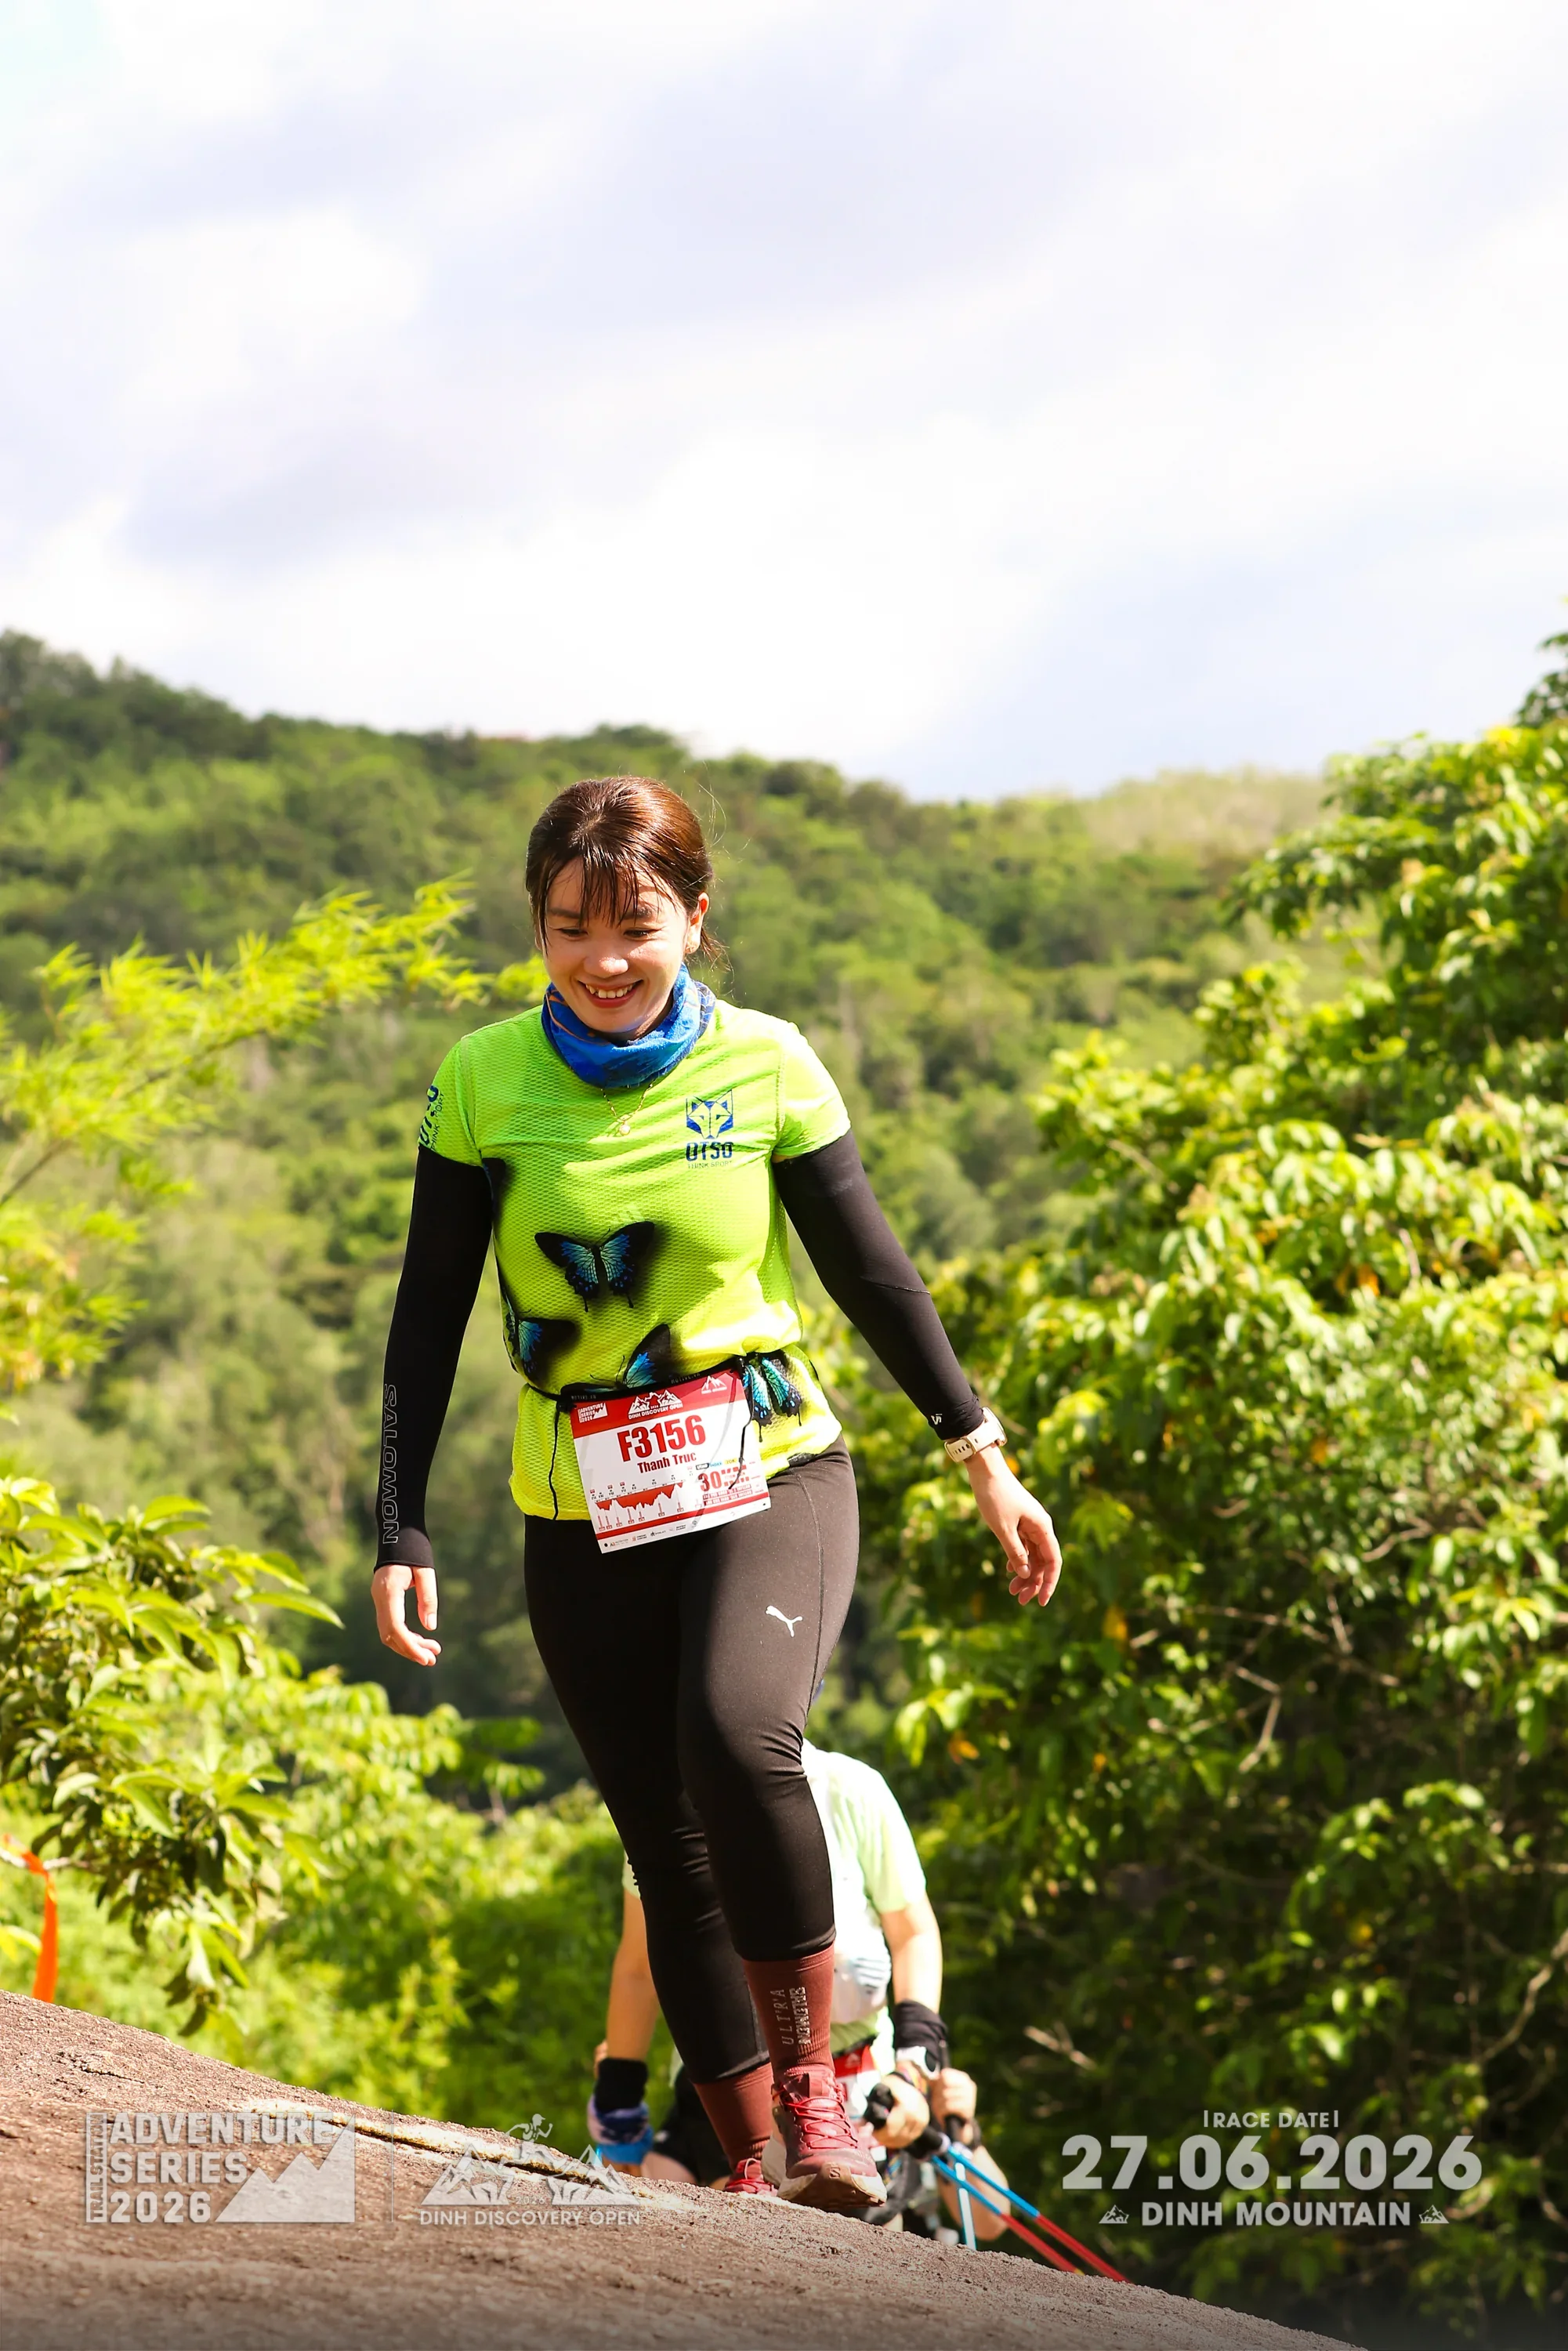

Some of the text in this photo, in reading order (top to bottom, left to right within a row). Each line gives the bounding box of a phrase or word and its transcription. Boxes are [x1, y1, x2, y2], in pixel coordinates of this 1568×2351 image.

[686, 1141, 733, 1161] UTSO
[642, 1407, 668, 1417] DISCOVERY
[617, 1415, 706, 1462] F3156
[382, 1383, 400, 1545] SALOMON
[637, 1451, 697, 1474] Thanh Truc
